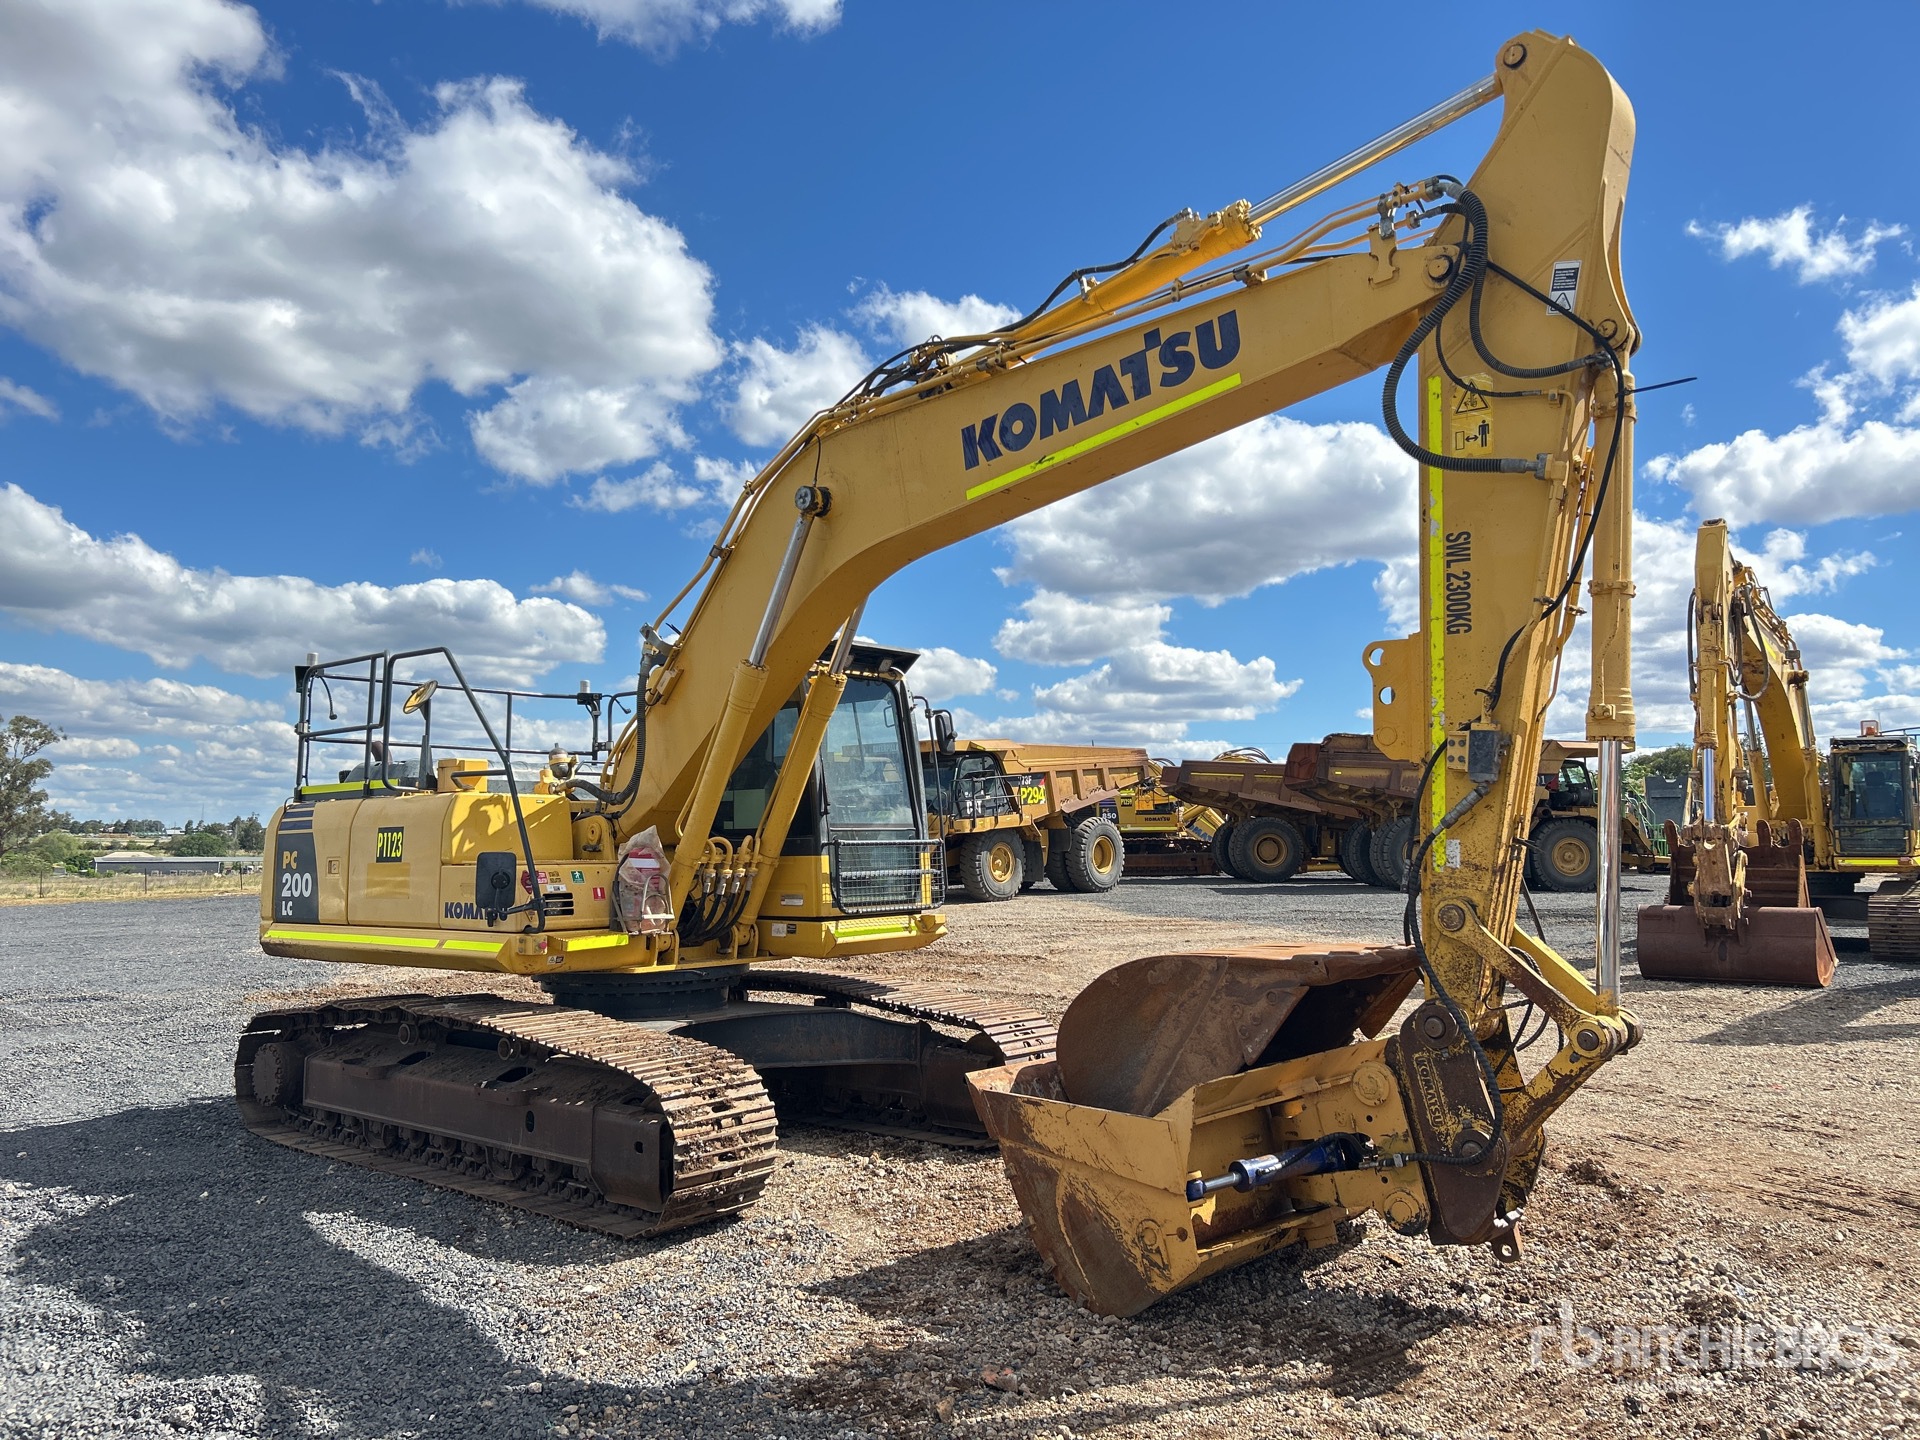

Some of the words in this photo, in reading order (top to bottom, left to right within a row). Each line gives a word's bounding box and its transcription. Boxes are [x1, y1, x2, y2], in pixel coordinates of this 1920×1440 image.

[961, 310, 1240, 471] KOMATSU
[1446, 531, 1471, 568] SWL
[1446, 571, 1472, 635] 2300KG
[1021, 786, 1046, 805] P294
[376, 831, 403, 858] P1123
[282, 850, 298, 870] PC
[281, 872, 313, 898] 200
[281, 900, 293, 916] LC
[1416, 1056, 1445, 1127] KOMATSU
